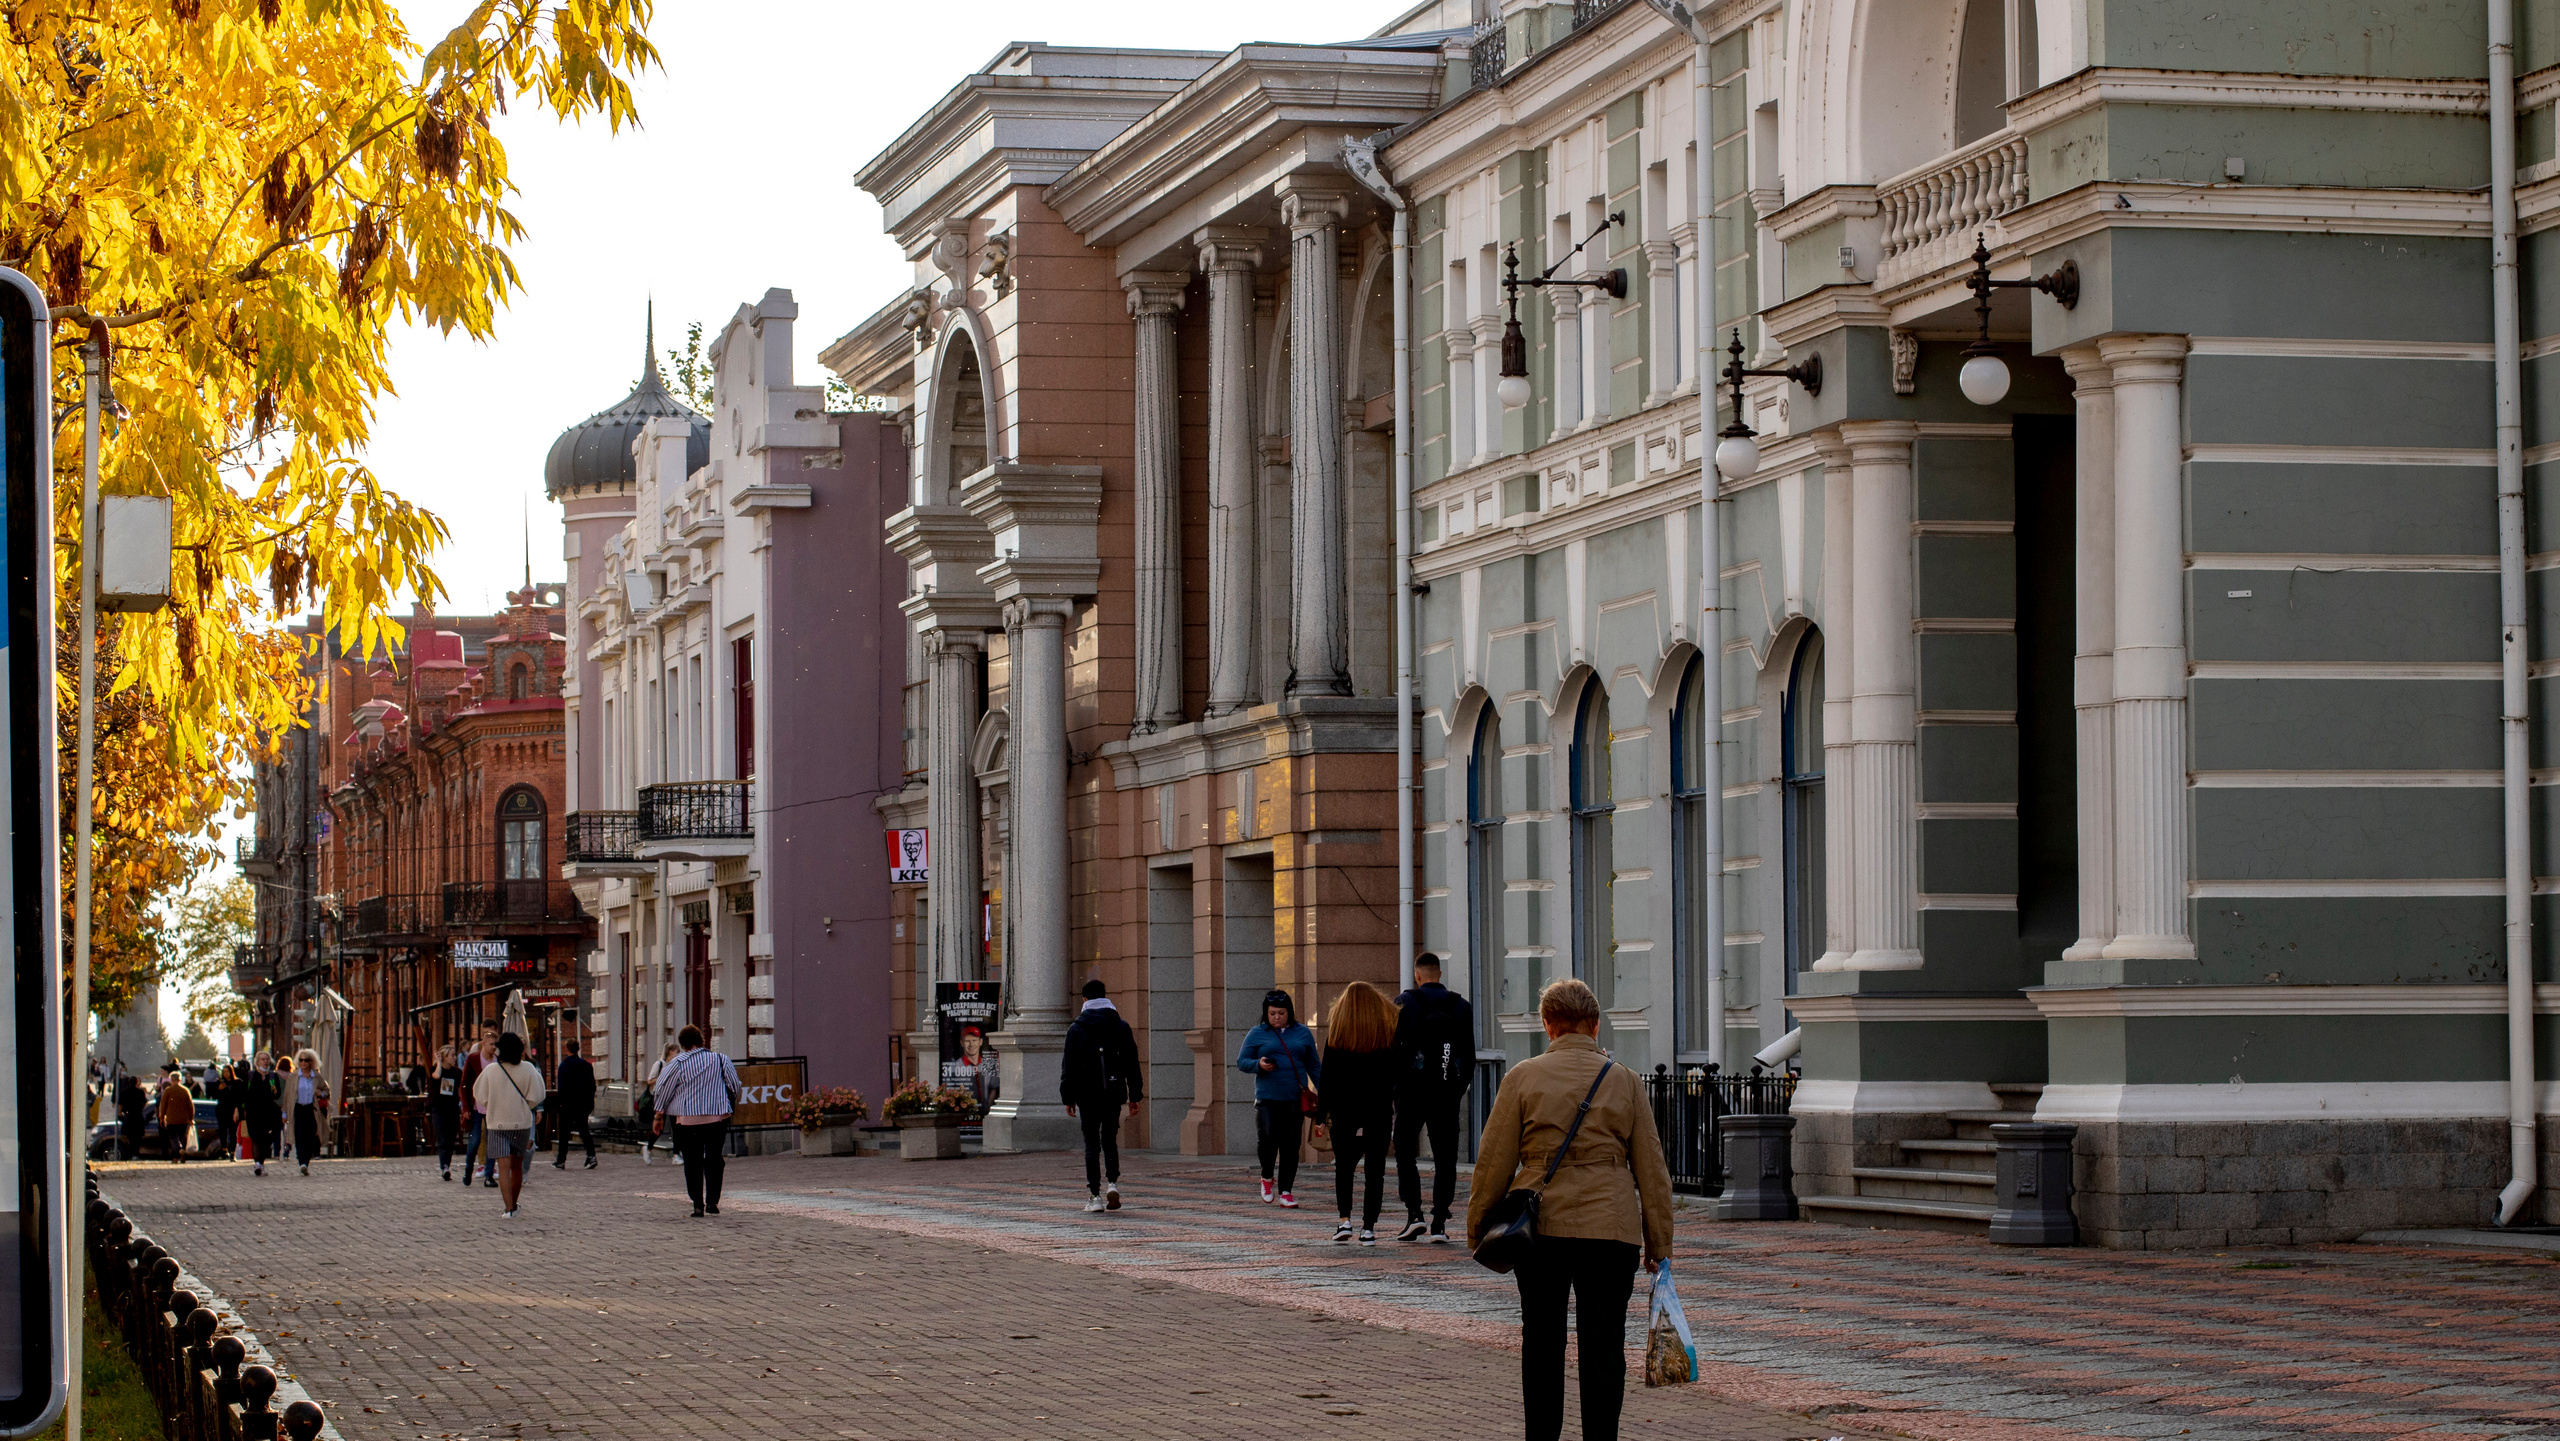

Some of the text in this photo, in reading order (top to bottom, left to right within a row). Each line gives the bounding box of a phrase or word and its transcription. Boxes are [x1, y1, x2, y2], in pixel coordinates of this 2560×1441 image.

[898, 869, 928, 881] KFC
[454, 943, 508, 957] МАКСИМ
[454, 960, 508, 970] гастромаркет
[524, 988, 576, 997] HARLEY-DAVIDSON
[959, 992, 978, 1000] KFC
[942, 1066, 952, 1077] 31
[739, 1084, 792, 1104] KFC
